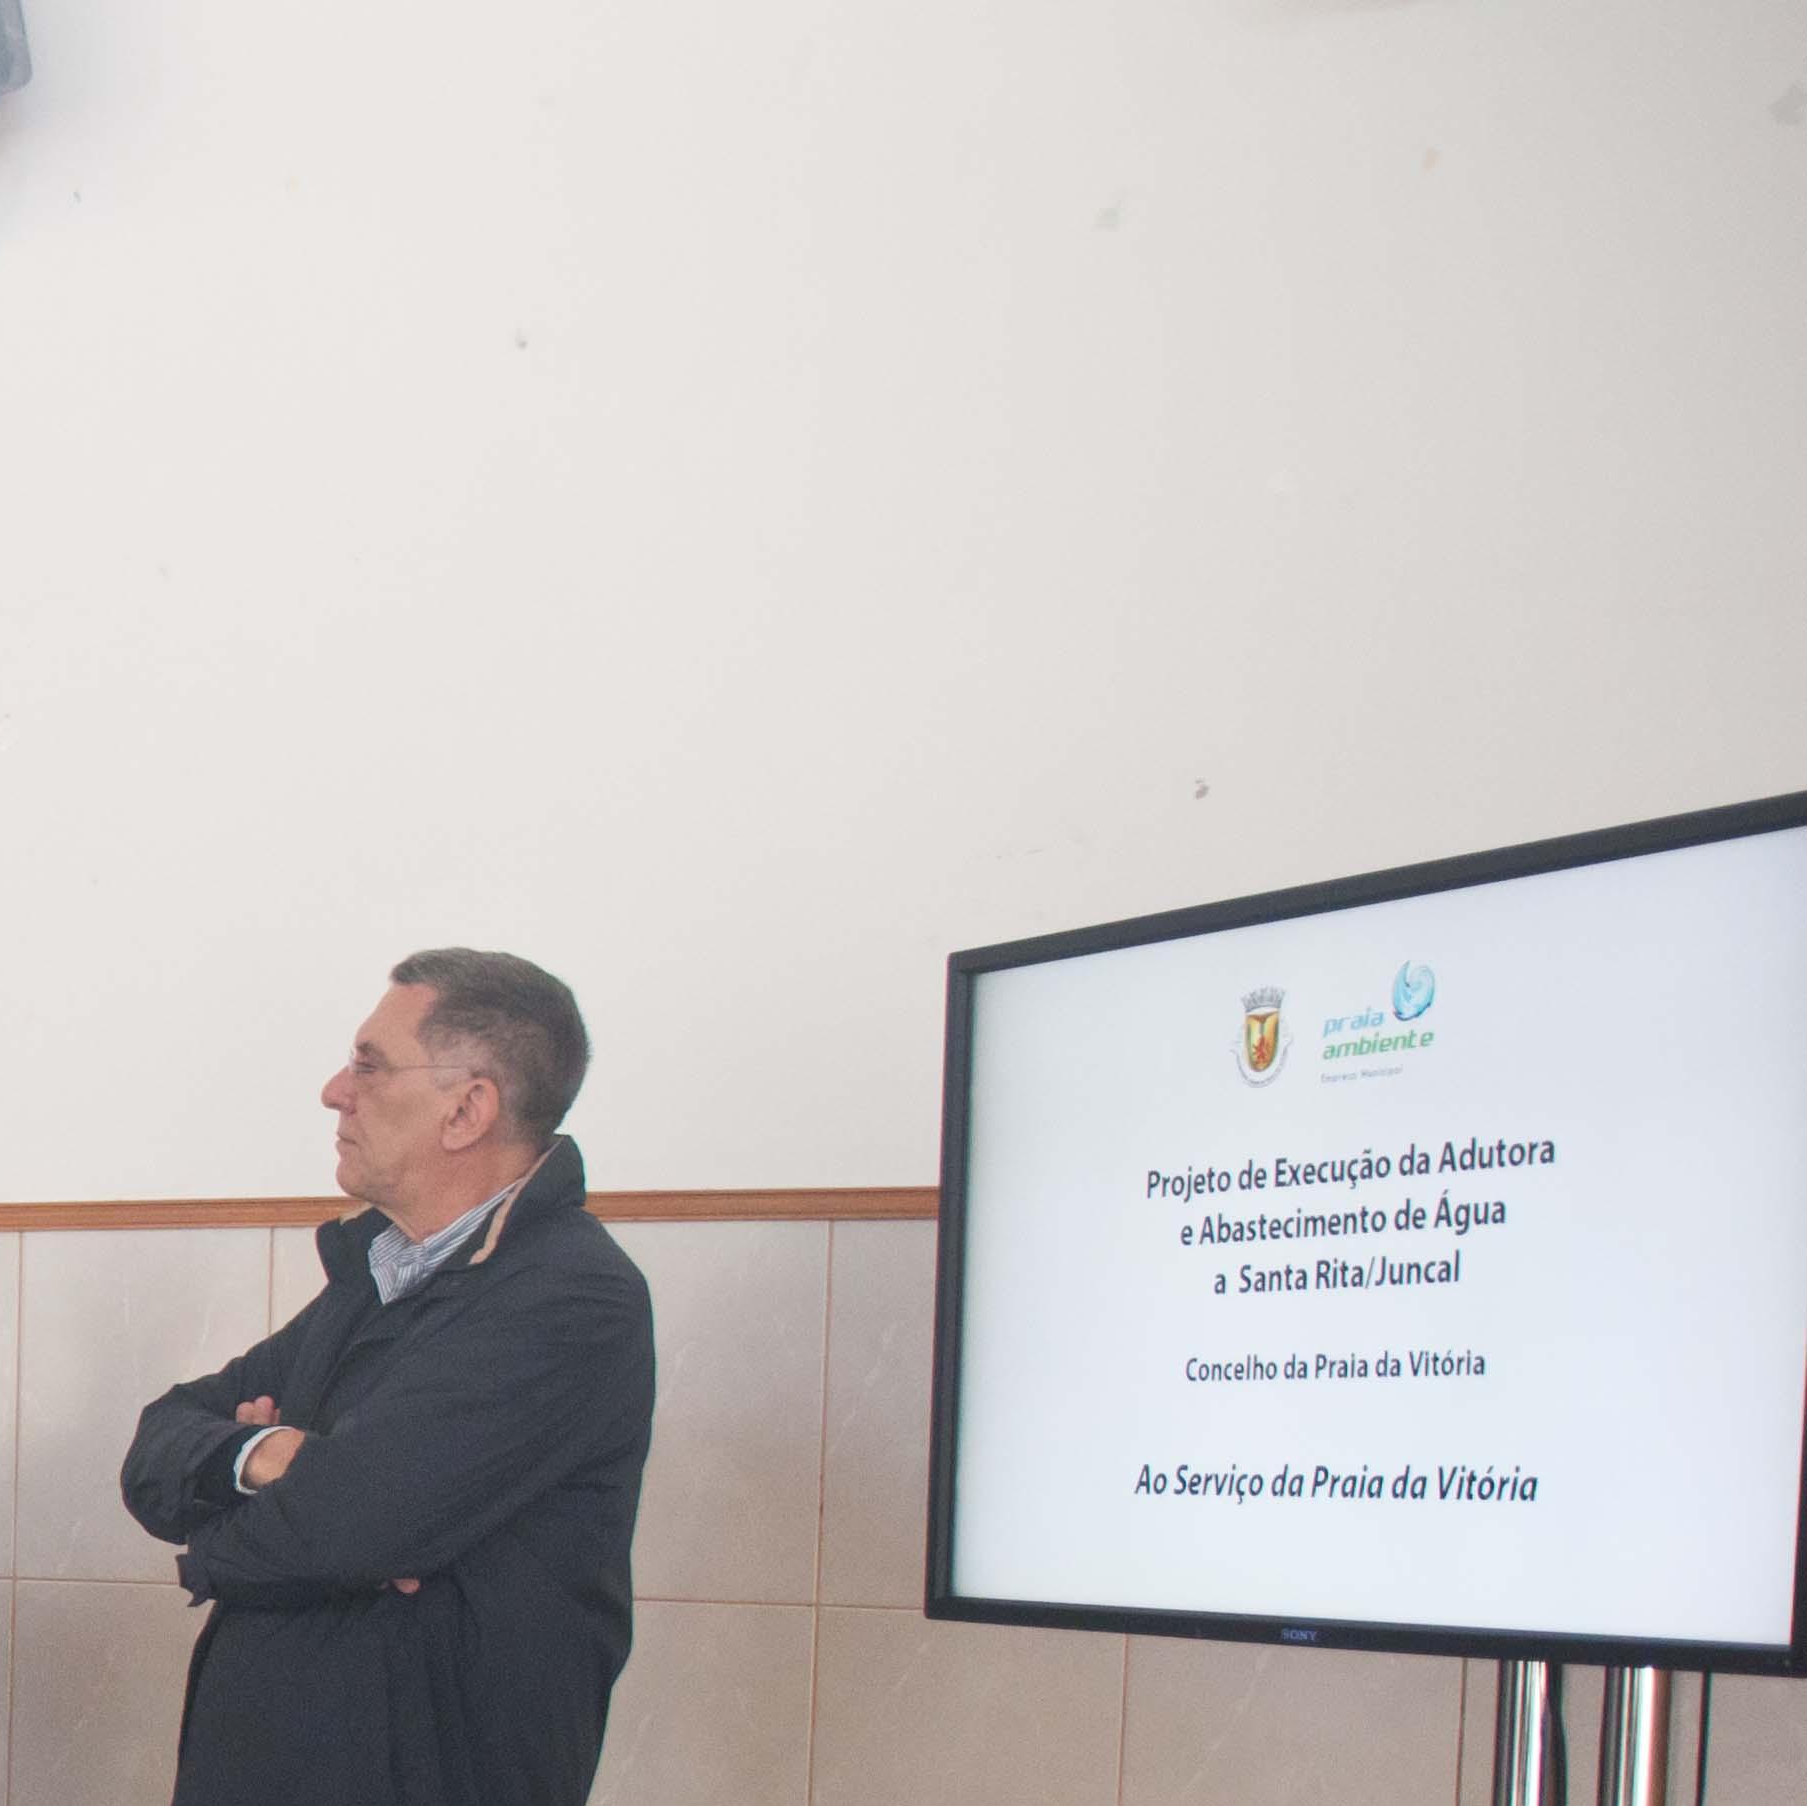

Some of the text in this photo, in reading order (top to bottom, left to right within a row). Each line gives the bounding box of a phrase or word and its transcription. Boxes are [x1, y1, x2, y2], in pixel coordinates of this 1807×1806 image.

[1322, 1006, 1385, 1038] praia
[1322, 1029, 1435, 1060] ambiente
[1147, 1136, 1555, 1203] Projeto de Execução da Adutora
[1180, 1189, 1507, 1246] e Abastecimento de Água
[1214, 1249, 1461, 1295] a Santa Rita/Juncal
[1185, 1349, 1486, 1382] Concelho da Praia da Vitória
[1134, 1463, 1539, 1505] Ao Serviço da Praia da Vitória
[1282, 1627, 1317, 1641] SONY
